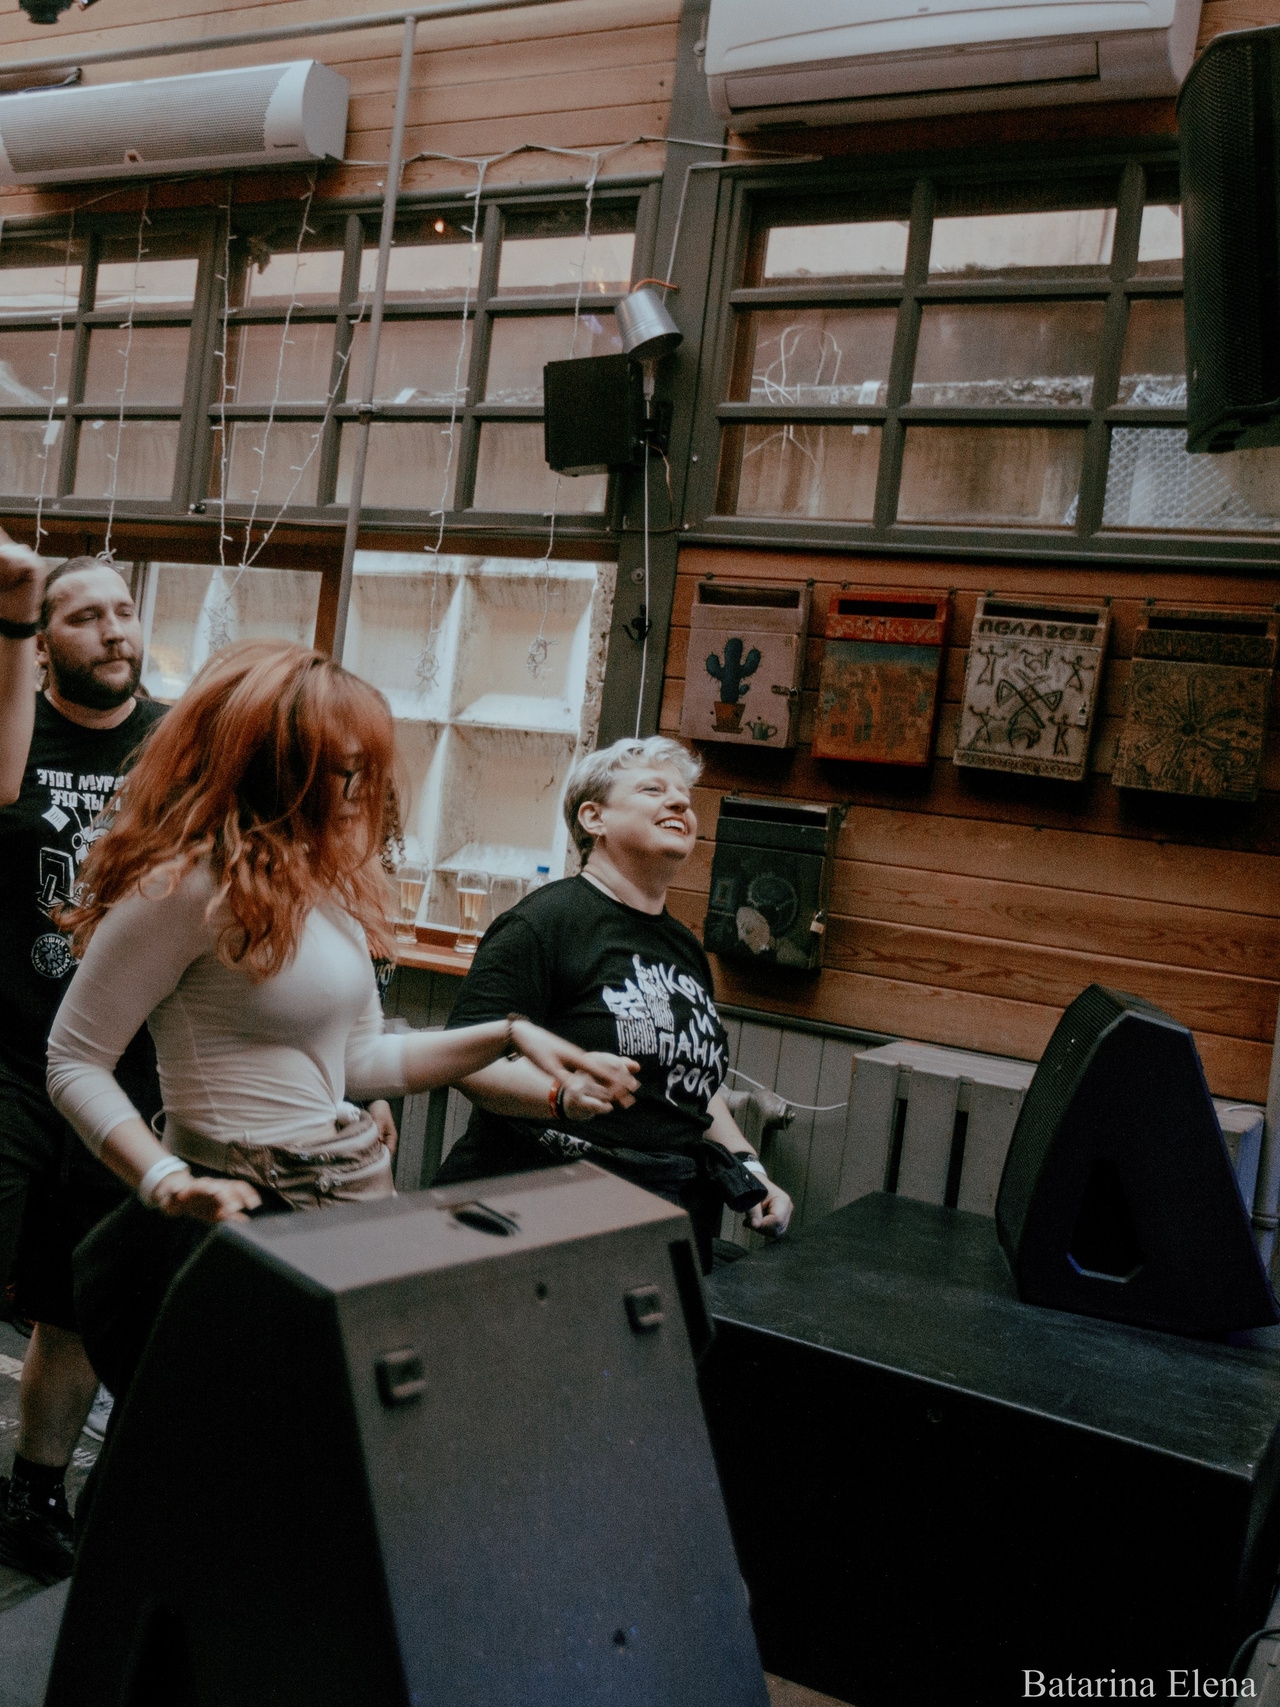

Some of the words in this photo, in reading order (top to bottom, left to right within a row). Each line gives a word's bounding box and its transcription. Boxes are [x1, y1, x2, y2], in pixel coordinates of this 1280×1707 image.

[78, 774, 130, 793] МУРА
[51, 952, 71, 975] САМЫЙ
[691, 1007, 716, 1037] И
[665, 1063, 716, 1107] РОК
